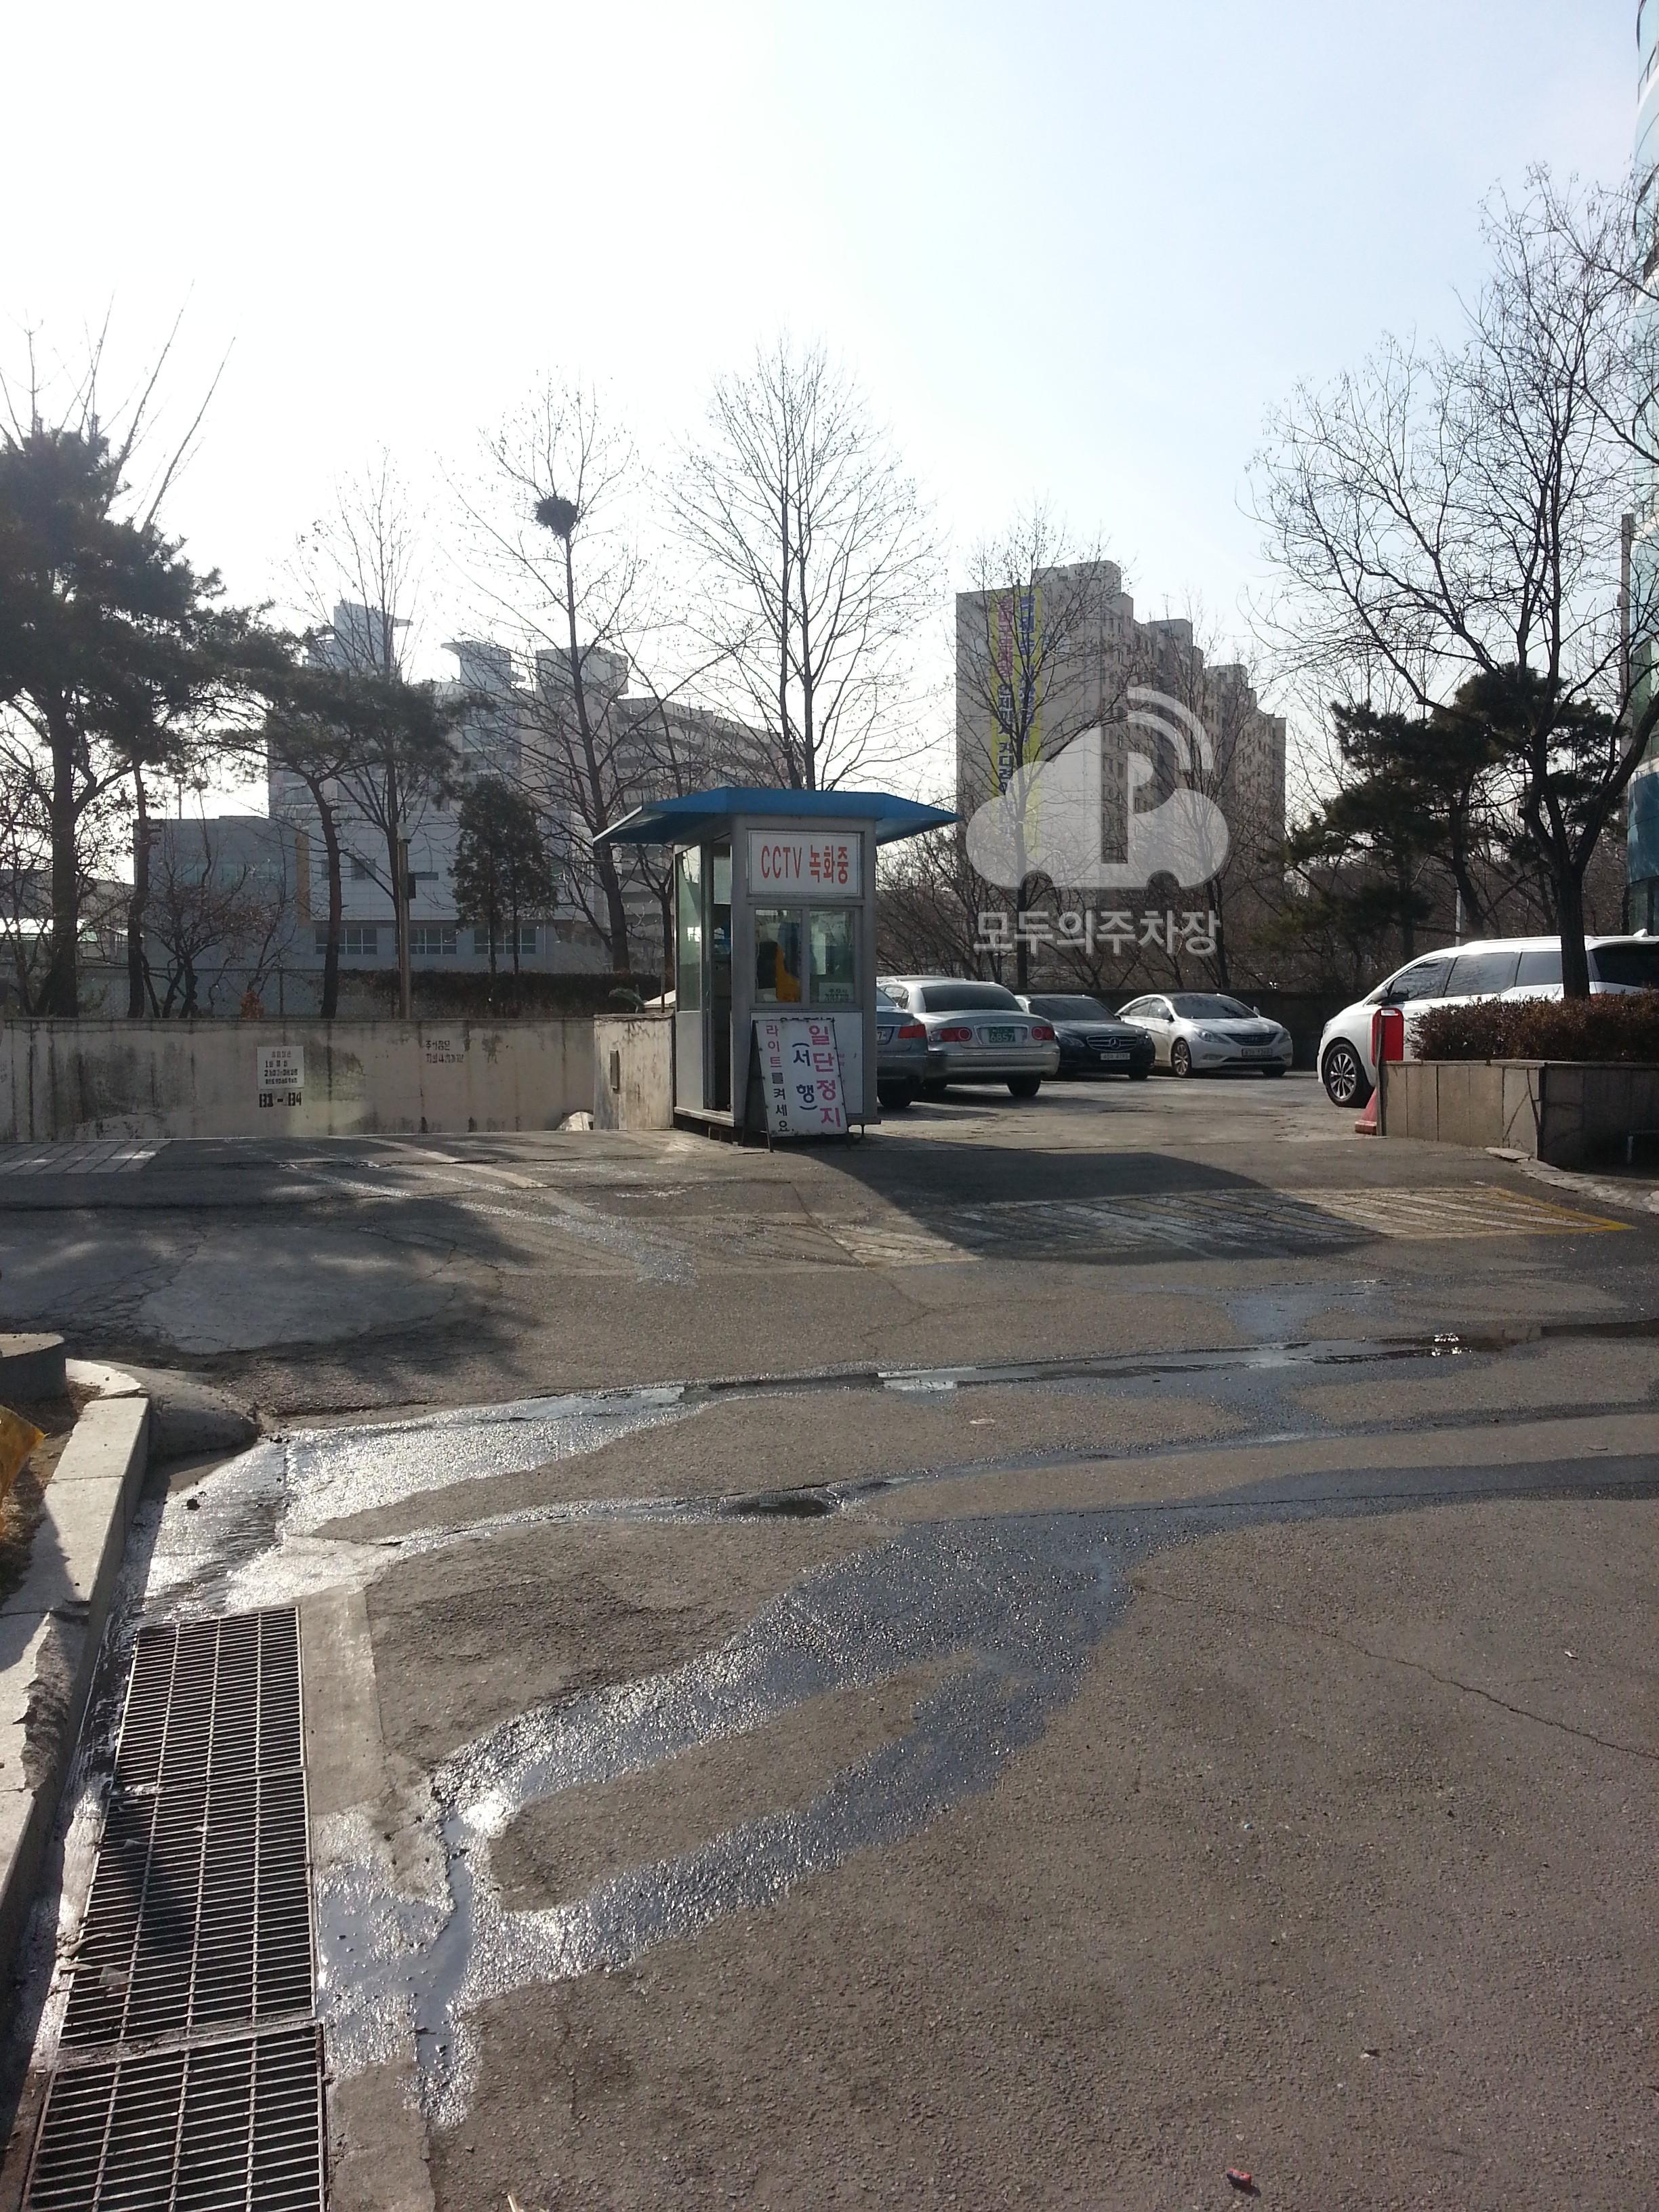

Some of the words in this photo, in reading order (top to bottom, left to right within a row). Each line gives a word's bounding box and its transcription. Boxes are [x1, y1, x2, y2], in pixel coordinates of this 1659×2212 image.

[761, 845, 802, 878] CCTV
[809, 844, 848, 884] 녹화중
[991, 1033, 1015, 1042] 6857
[808, 1025, 848, 1128] 일단정지
